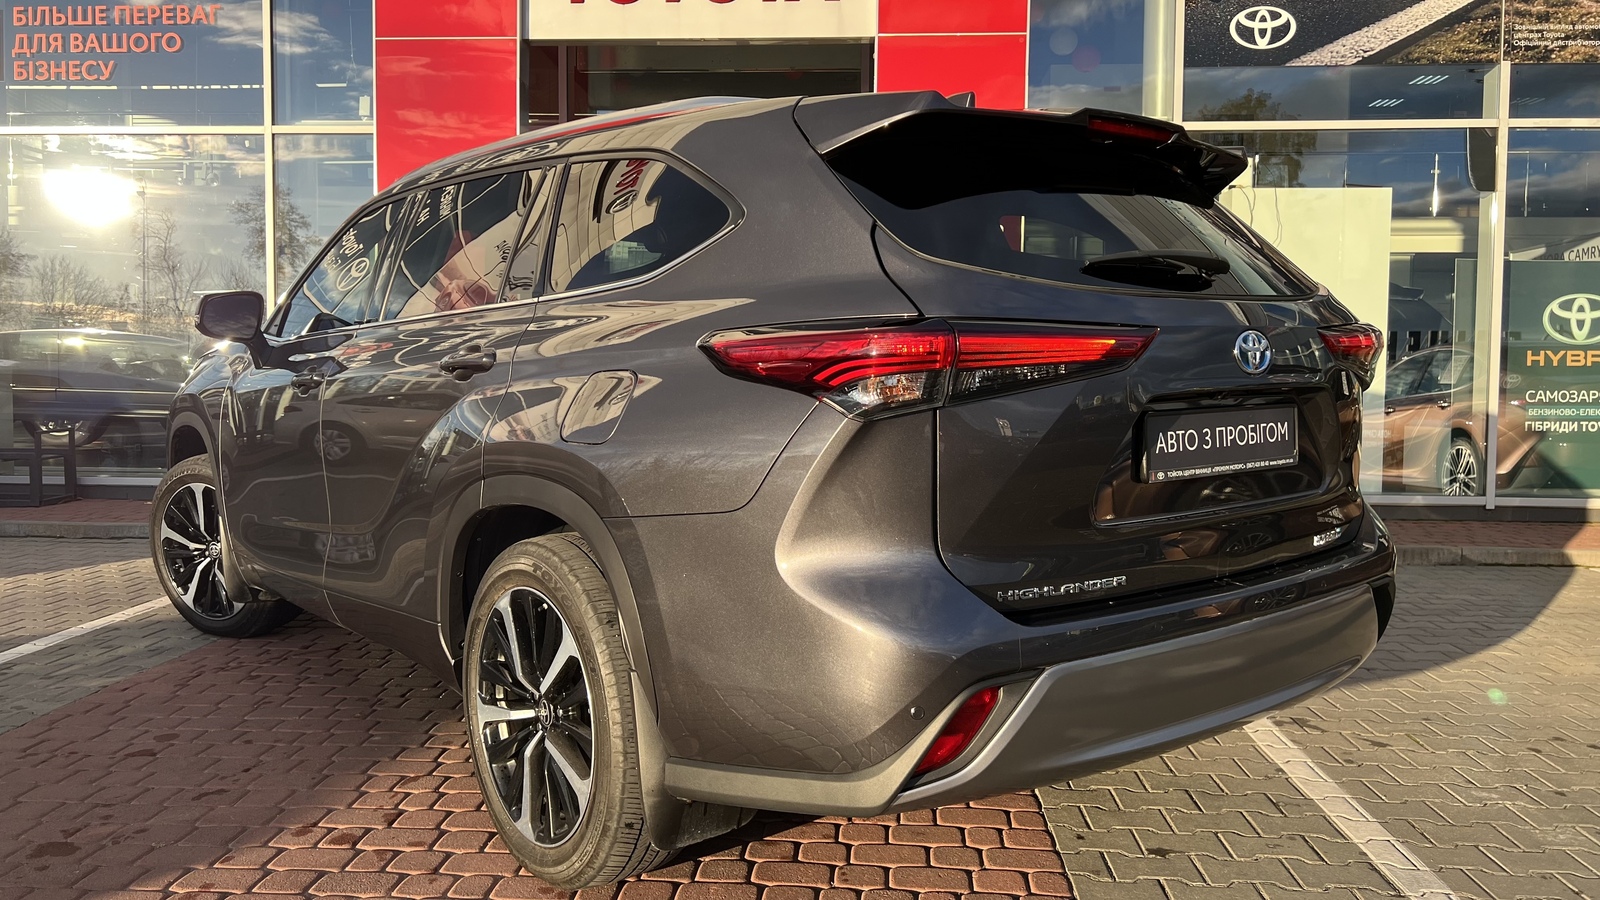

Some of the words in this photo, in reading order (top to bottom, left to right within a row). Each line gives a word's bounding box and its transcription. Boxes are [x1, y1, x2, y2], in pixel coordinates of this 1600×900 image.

[13, 6, 107, 26] БІЛЬШЕ
[114, 5, 221, 25] ПЕРЕВАГ
[12, 33, 62, 57] ДЛЯ
[70, 32, 182, 53] ВАШОГО
[1543, 31, 1565, 39] Toyota
[14, 60, 115, 80] БІЗНЕСУ
[1525, 390, 1600, 403] САМОЗАР
[1524, 421, 1578, 433] ГІБРИДИ
[1155, 429, 1199, 454] АВТО
[1216, 421, 1289, 448] ПРОБІГОМ
[996, 575, 1127, 602] HIGHLANDER
